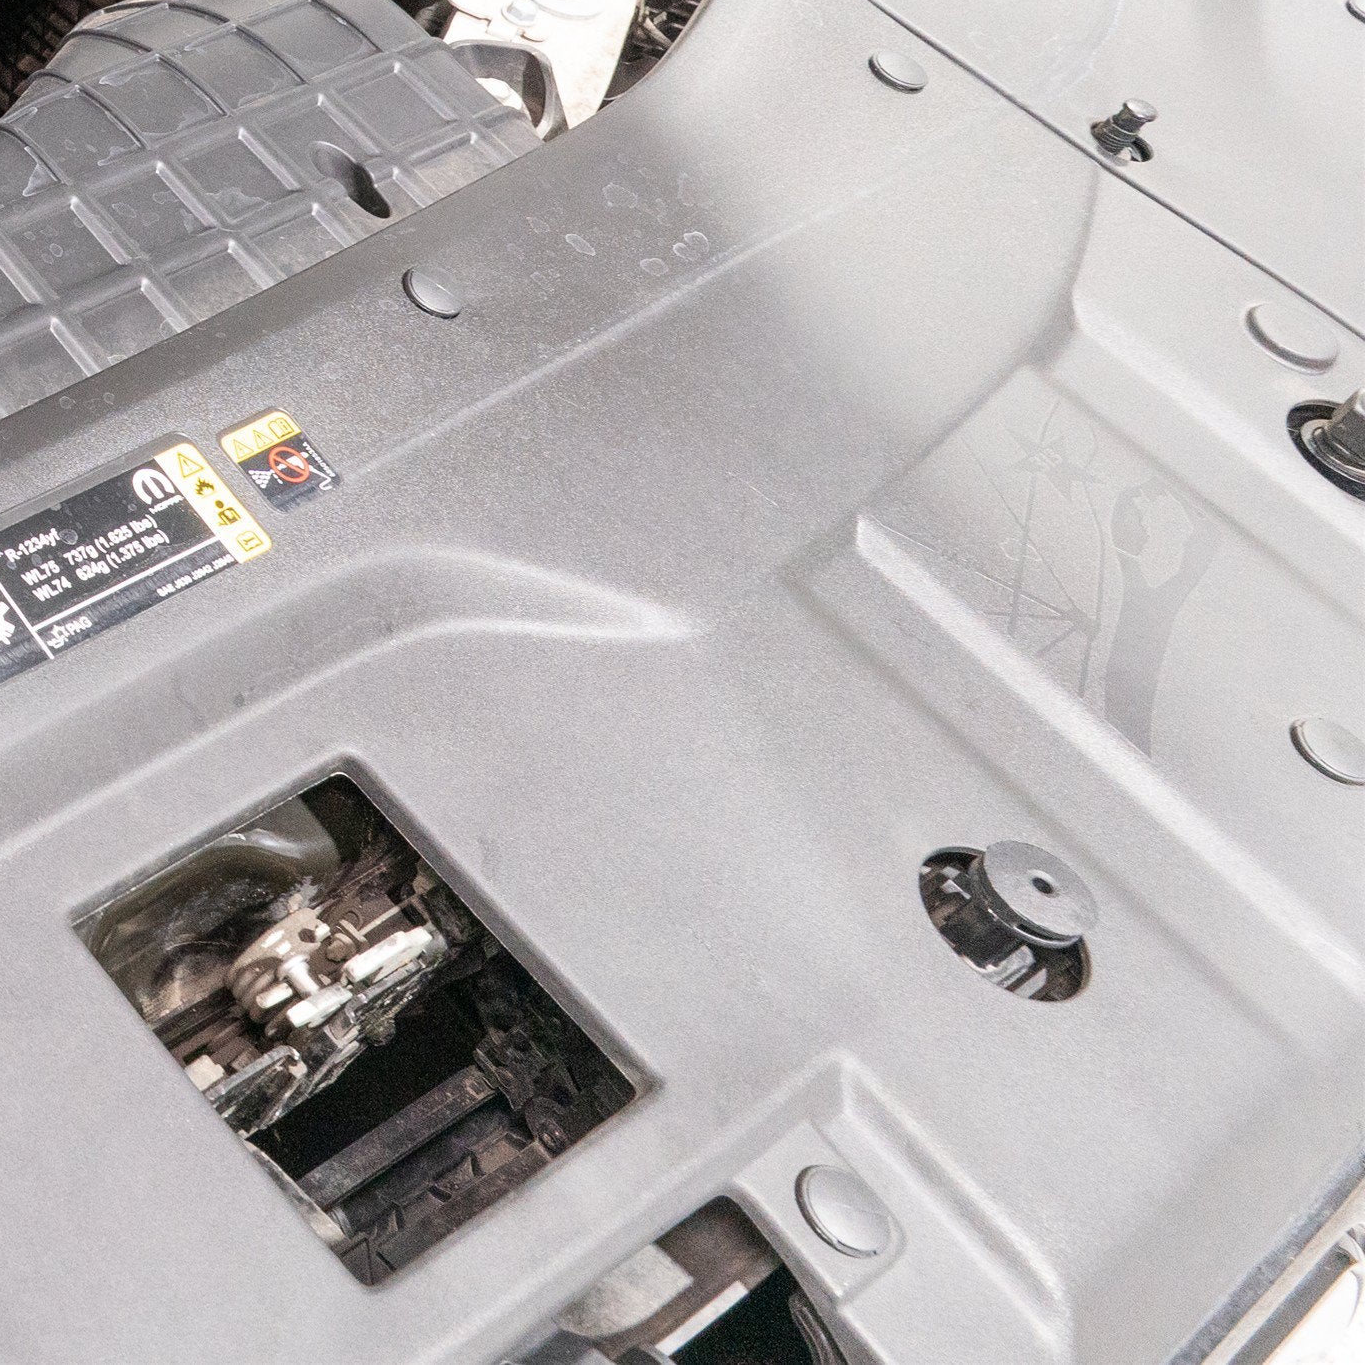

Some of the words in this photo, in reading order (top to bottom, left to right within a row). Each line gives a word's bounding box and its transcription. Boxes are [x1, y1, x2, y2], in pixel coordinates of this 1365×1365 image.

[4, 527, 61, 563] R-1234yf
[21, 560, 60, 586] WL75
[63, 543, 99, 566] 737g
[32, 575, 72, 602] WL74
[75, 559, 111, 581] 624g
[67, 616, 93, 636] PAG
